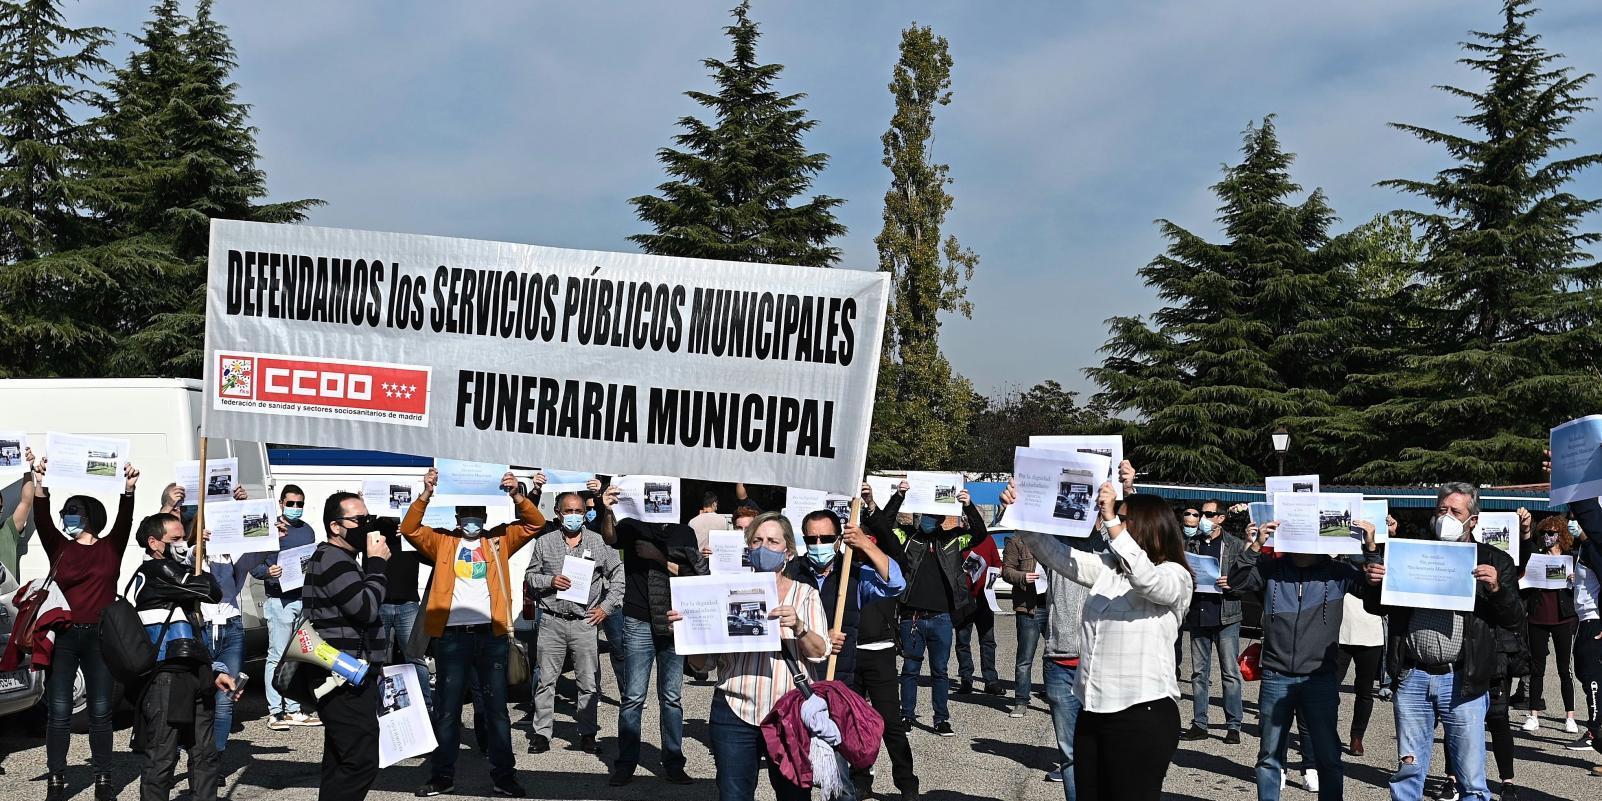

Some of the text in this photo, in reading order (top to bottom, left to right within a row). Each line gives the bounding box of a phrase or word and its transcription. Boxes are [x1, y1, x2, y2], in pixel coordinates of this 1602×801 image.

[226, 249, 857, 367] DEFENDAMOS los SERVICIOS PÚBLICOS MUNICIPALES
[265, 367, 373, 401] CCOO
[221, 398, 257, 407] federación
[302, 405, 333, 413] sectores
[334, 408, 387, 418] sociosanitarios
[398, 413, 423, 421] madrid
[455, 369, 836, 460] FUNERARIA MUNICIPAL
[1590, 680, 1598, 721] Champion
